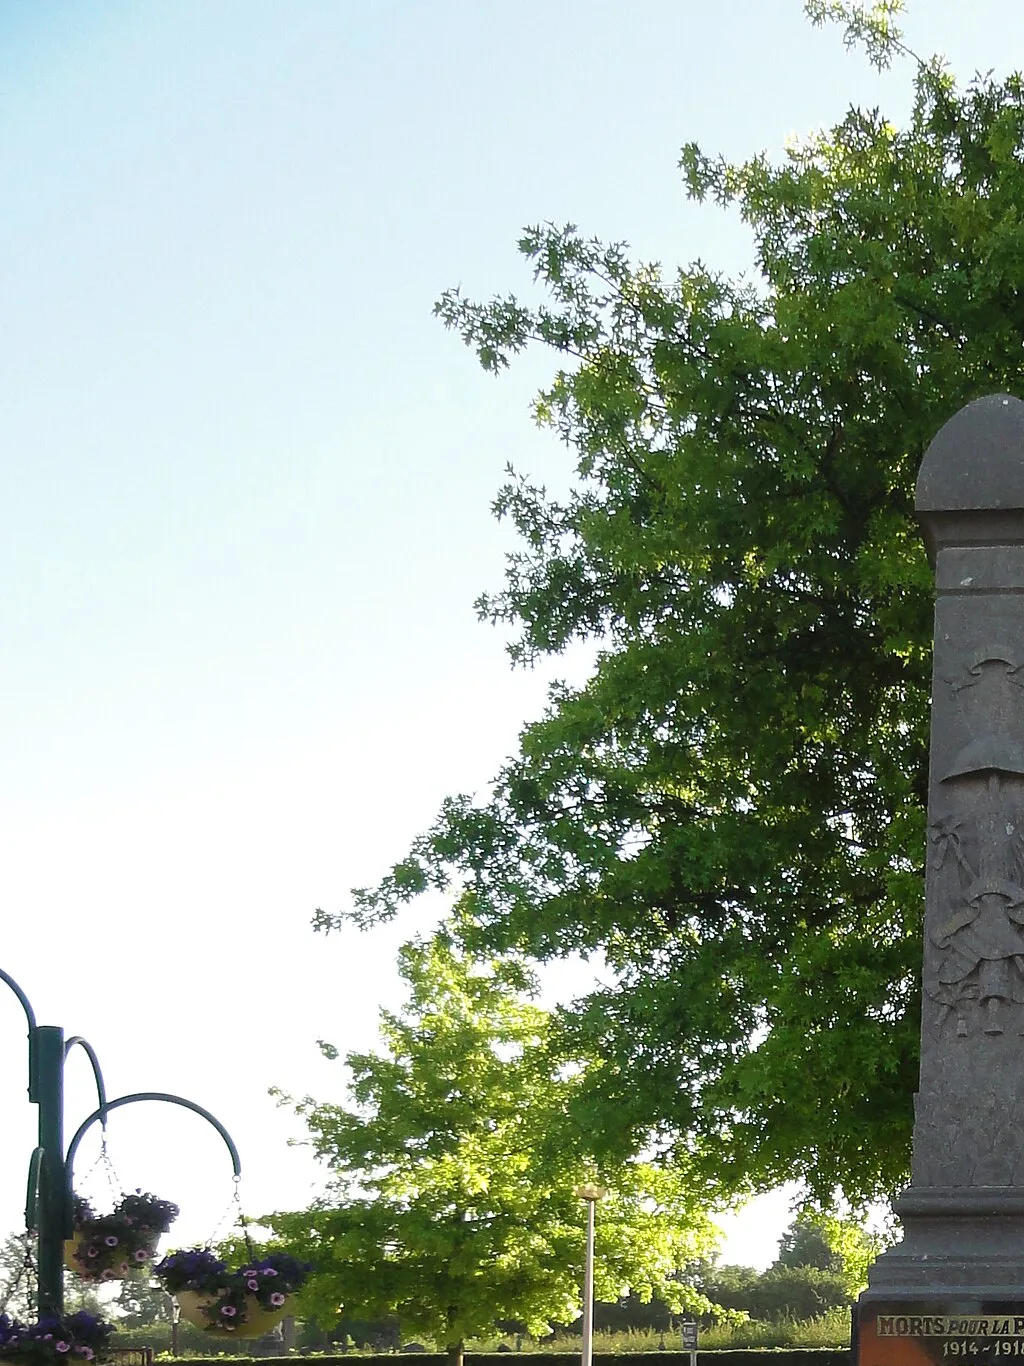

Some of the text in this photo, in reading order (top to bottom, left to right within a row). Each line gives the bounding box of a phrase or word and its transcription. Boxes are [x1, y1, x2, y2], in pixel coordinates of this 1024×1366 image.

[879, 1317, 944, 1335] MORTS
[948, 1320, 987, 1335] POUR
[990, 1320, 1010, 1335] LA
